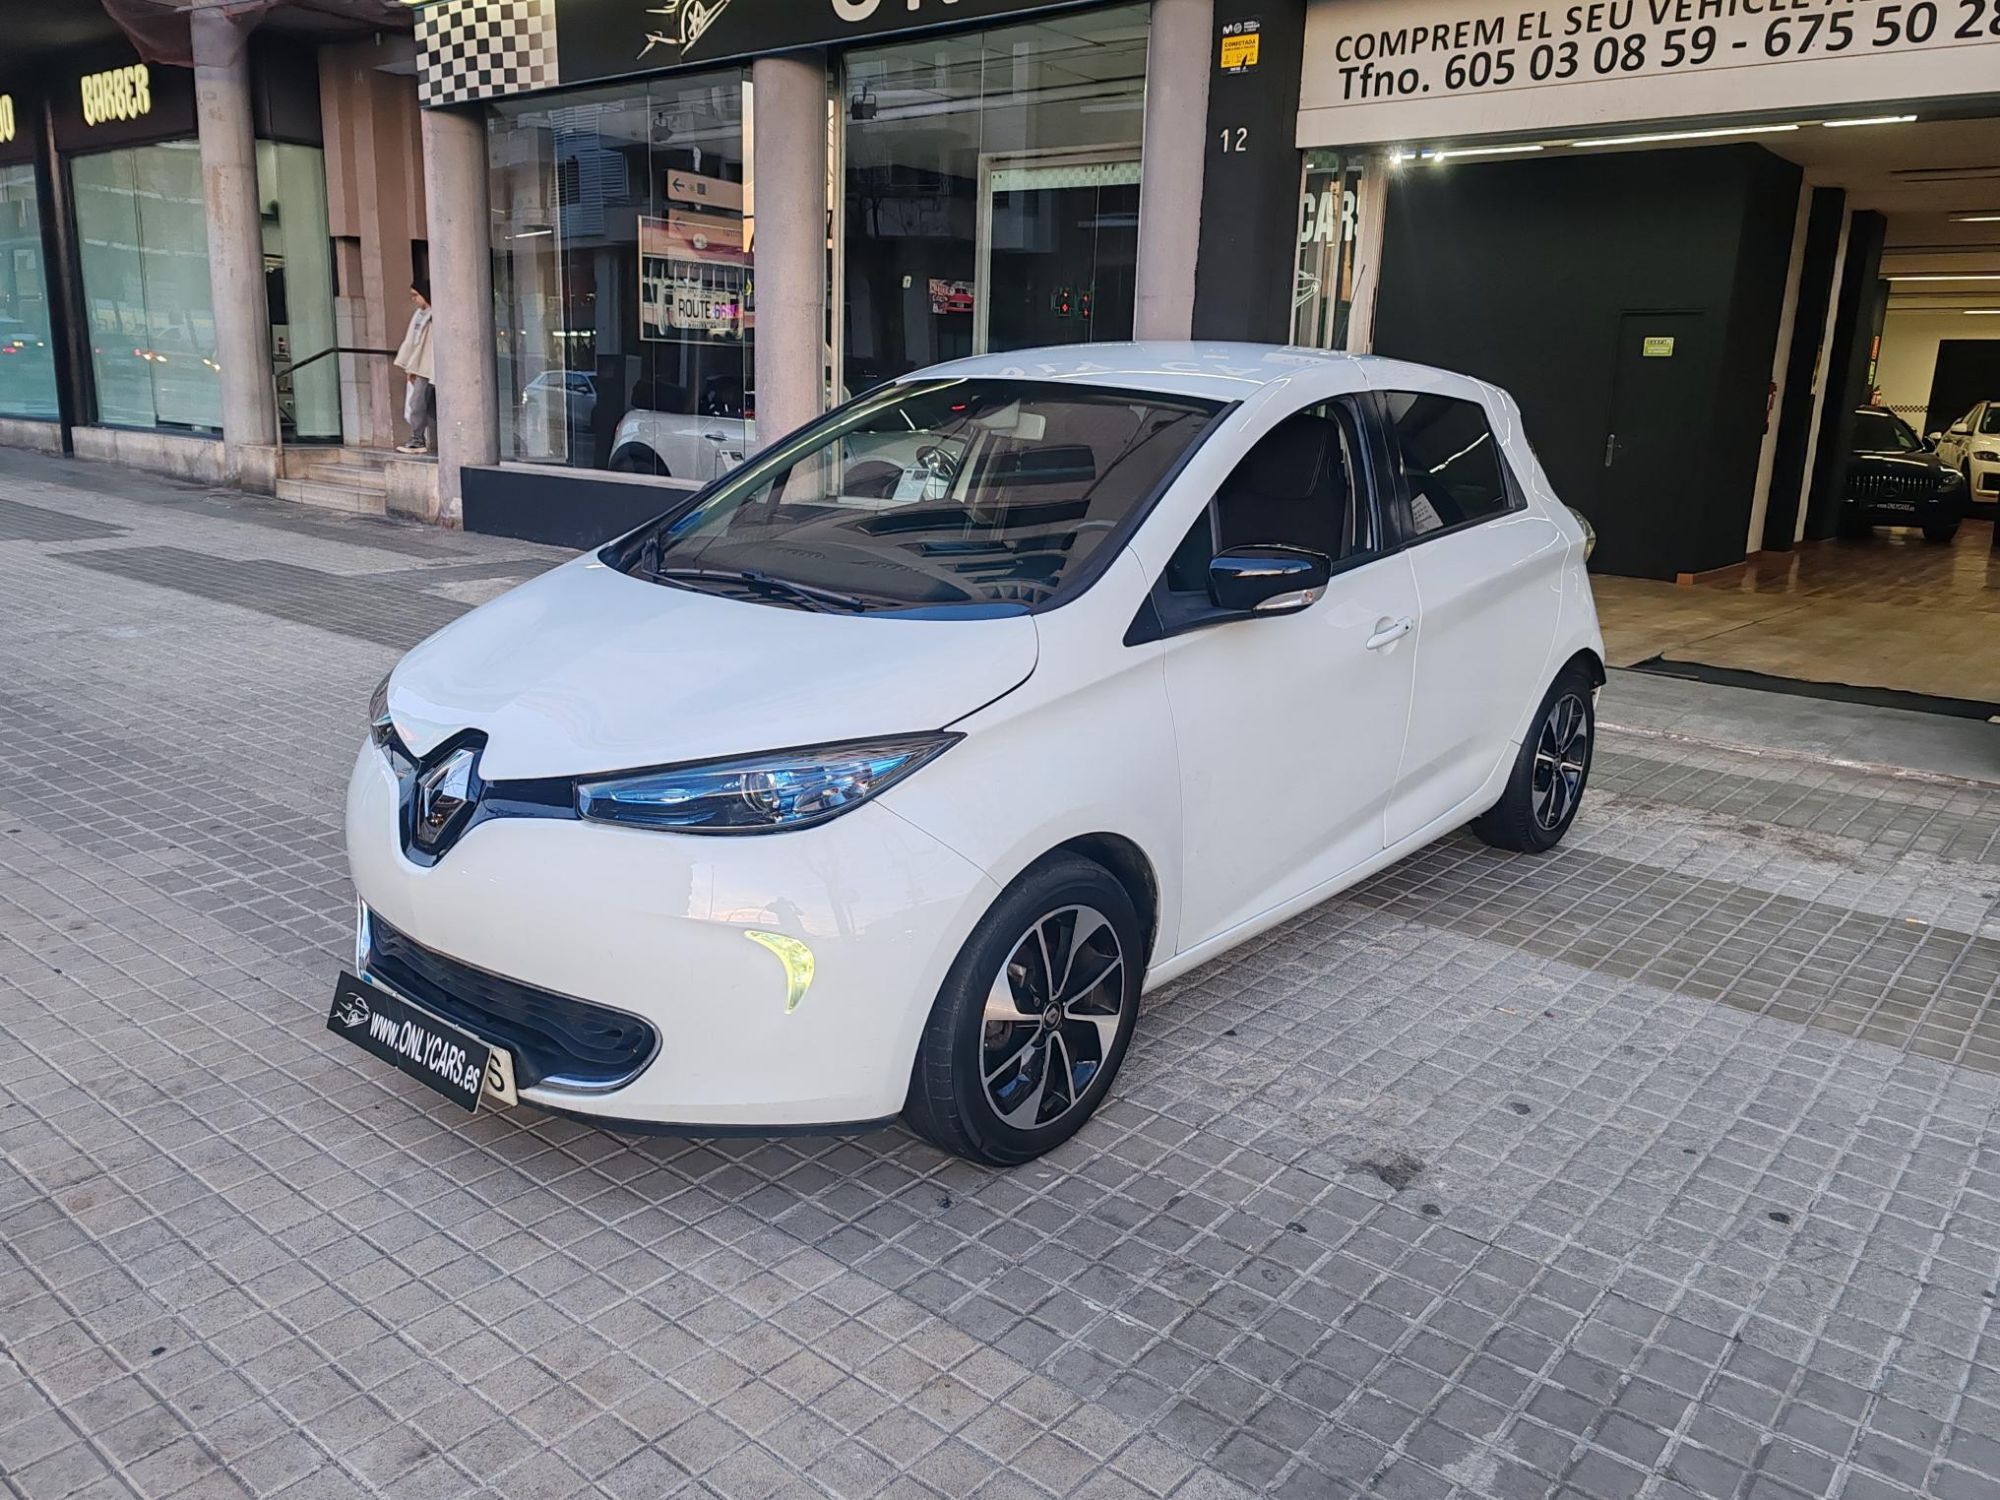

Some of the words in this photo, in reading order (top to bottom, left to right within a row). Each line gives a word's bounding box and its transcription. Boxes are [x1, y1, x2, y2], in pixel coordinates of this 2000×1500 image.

[1335, 16, 1505, 62] COMPREM
[1517, 11, 1552, 42] EL
[1564, 0, 1633, 36] SEU
[1338, 63, 1429, 100] Tfno.
[1445, 49, 1515, 90] 605
[1529, 41, 1578, 80] 03
[1593, 33, 1646, 74] 08
[1661, 25, 1716, 67] 59
[1732, 41, 1747, 49] -
[1764, 10, 1854, 57] 675
[1872, 1, 1938, 47] 50
[81, 63, 150, 126] BARBER
[1220, 127, 1248, 153] 12
[1300, 190, 1359, 243] CAR
[678, 298, 711, 319] ROUTE
[714, 301, 727, 321] 66
[369, 1011, 480, 1094] www.ONLYCARS.es
